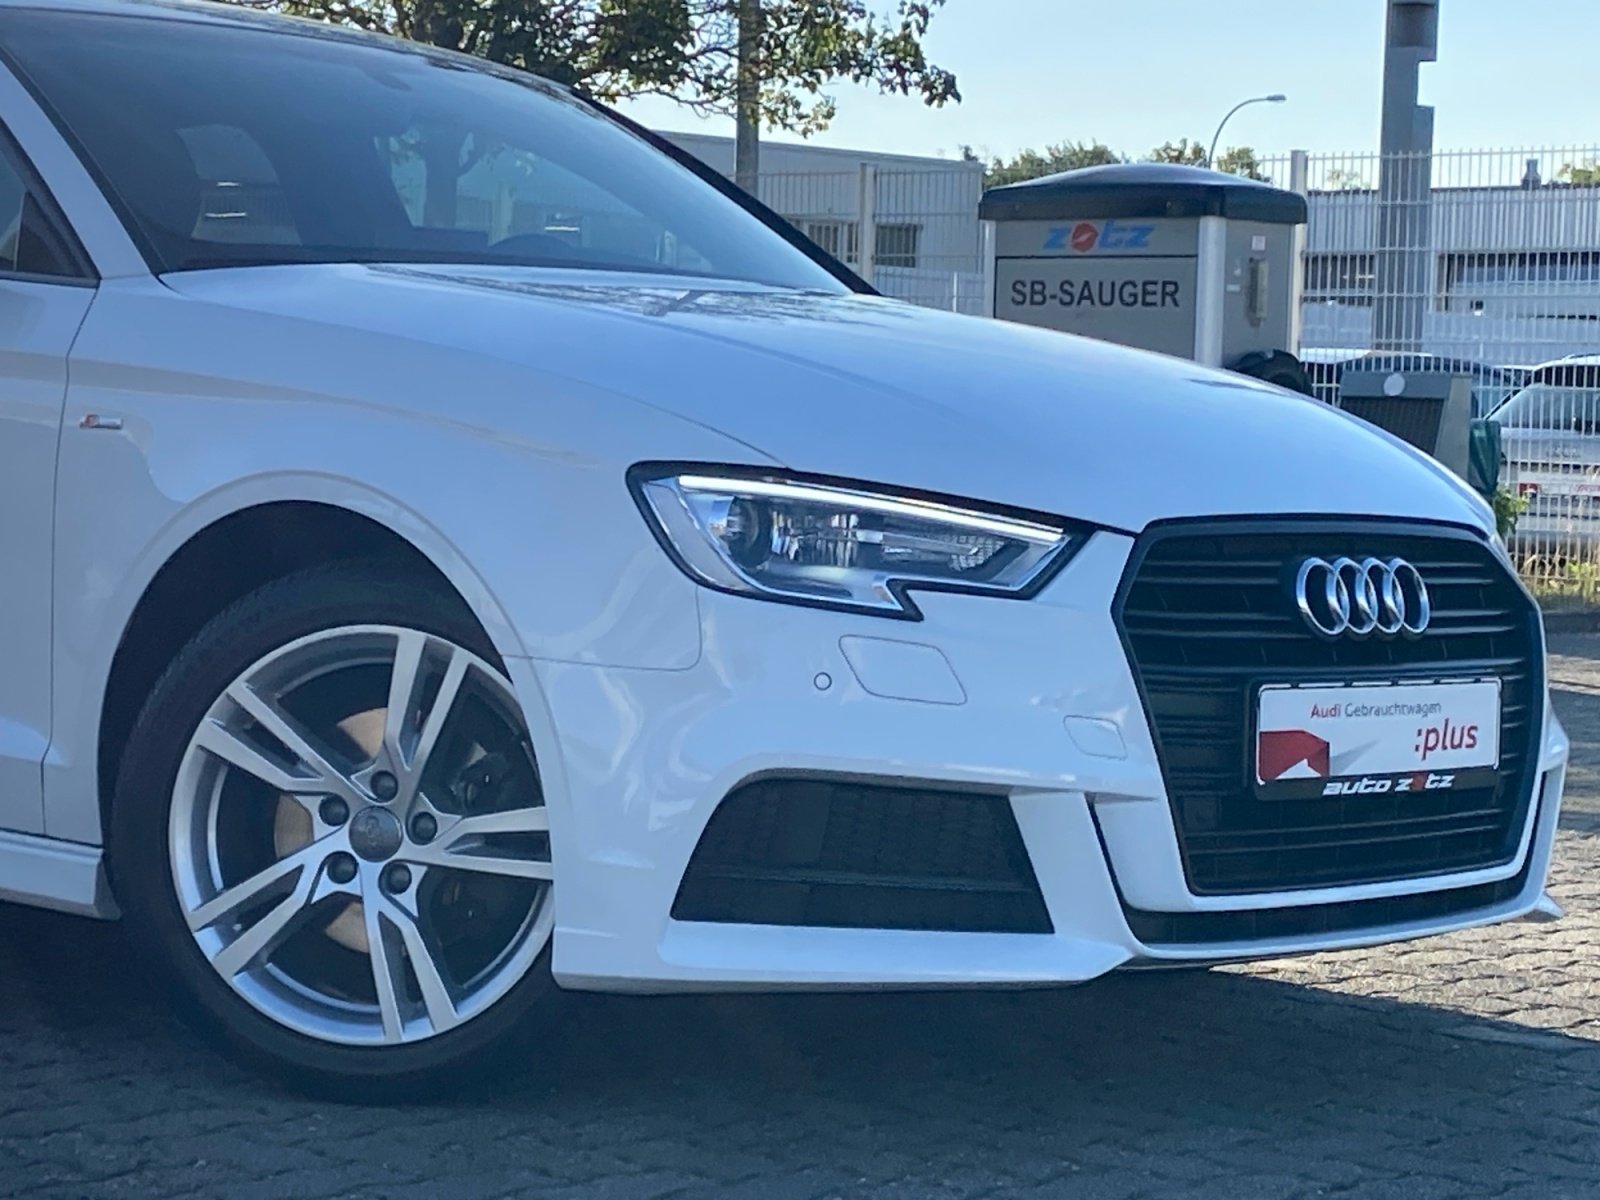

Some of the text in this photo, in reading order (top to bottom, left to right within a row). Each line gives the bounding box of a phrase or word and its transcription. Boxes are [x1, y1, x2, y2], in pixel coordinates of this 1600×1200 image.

[1011, 279, 1180, 307] SB-SAUGER
[1311, 701, 1441, 719] Audi Gebrauchtwagen
[1322, 777, 1392, 796] auto
